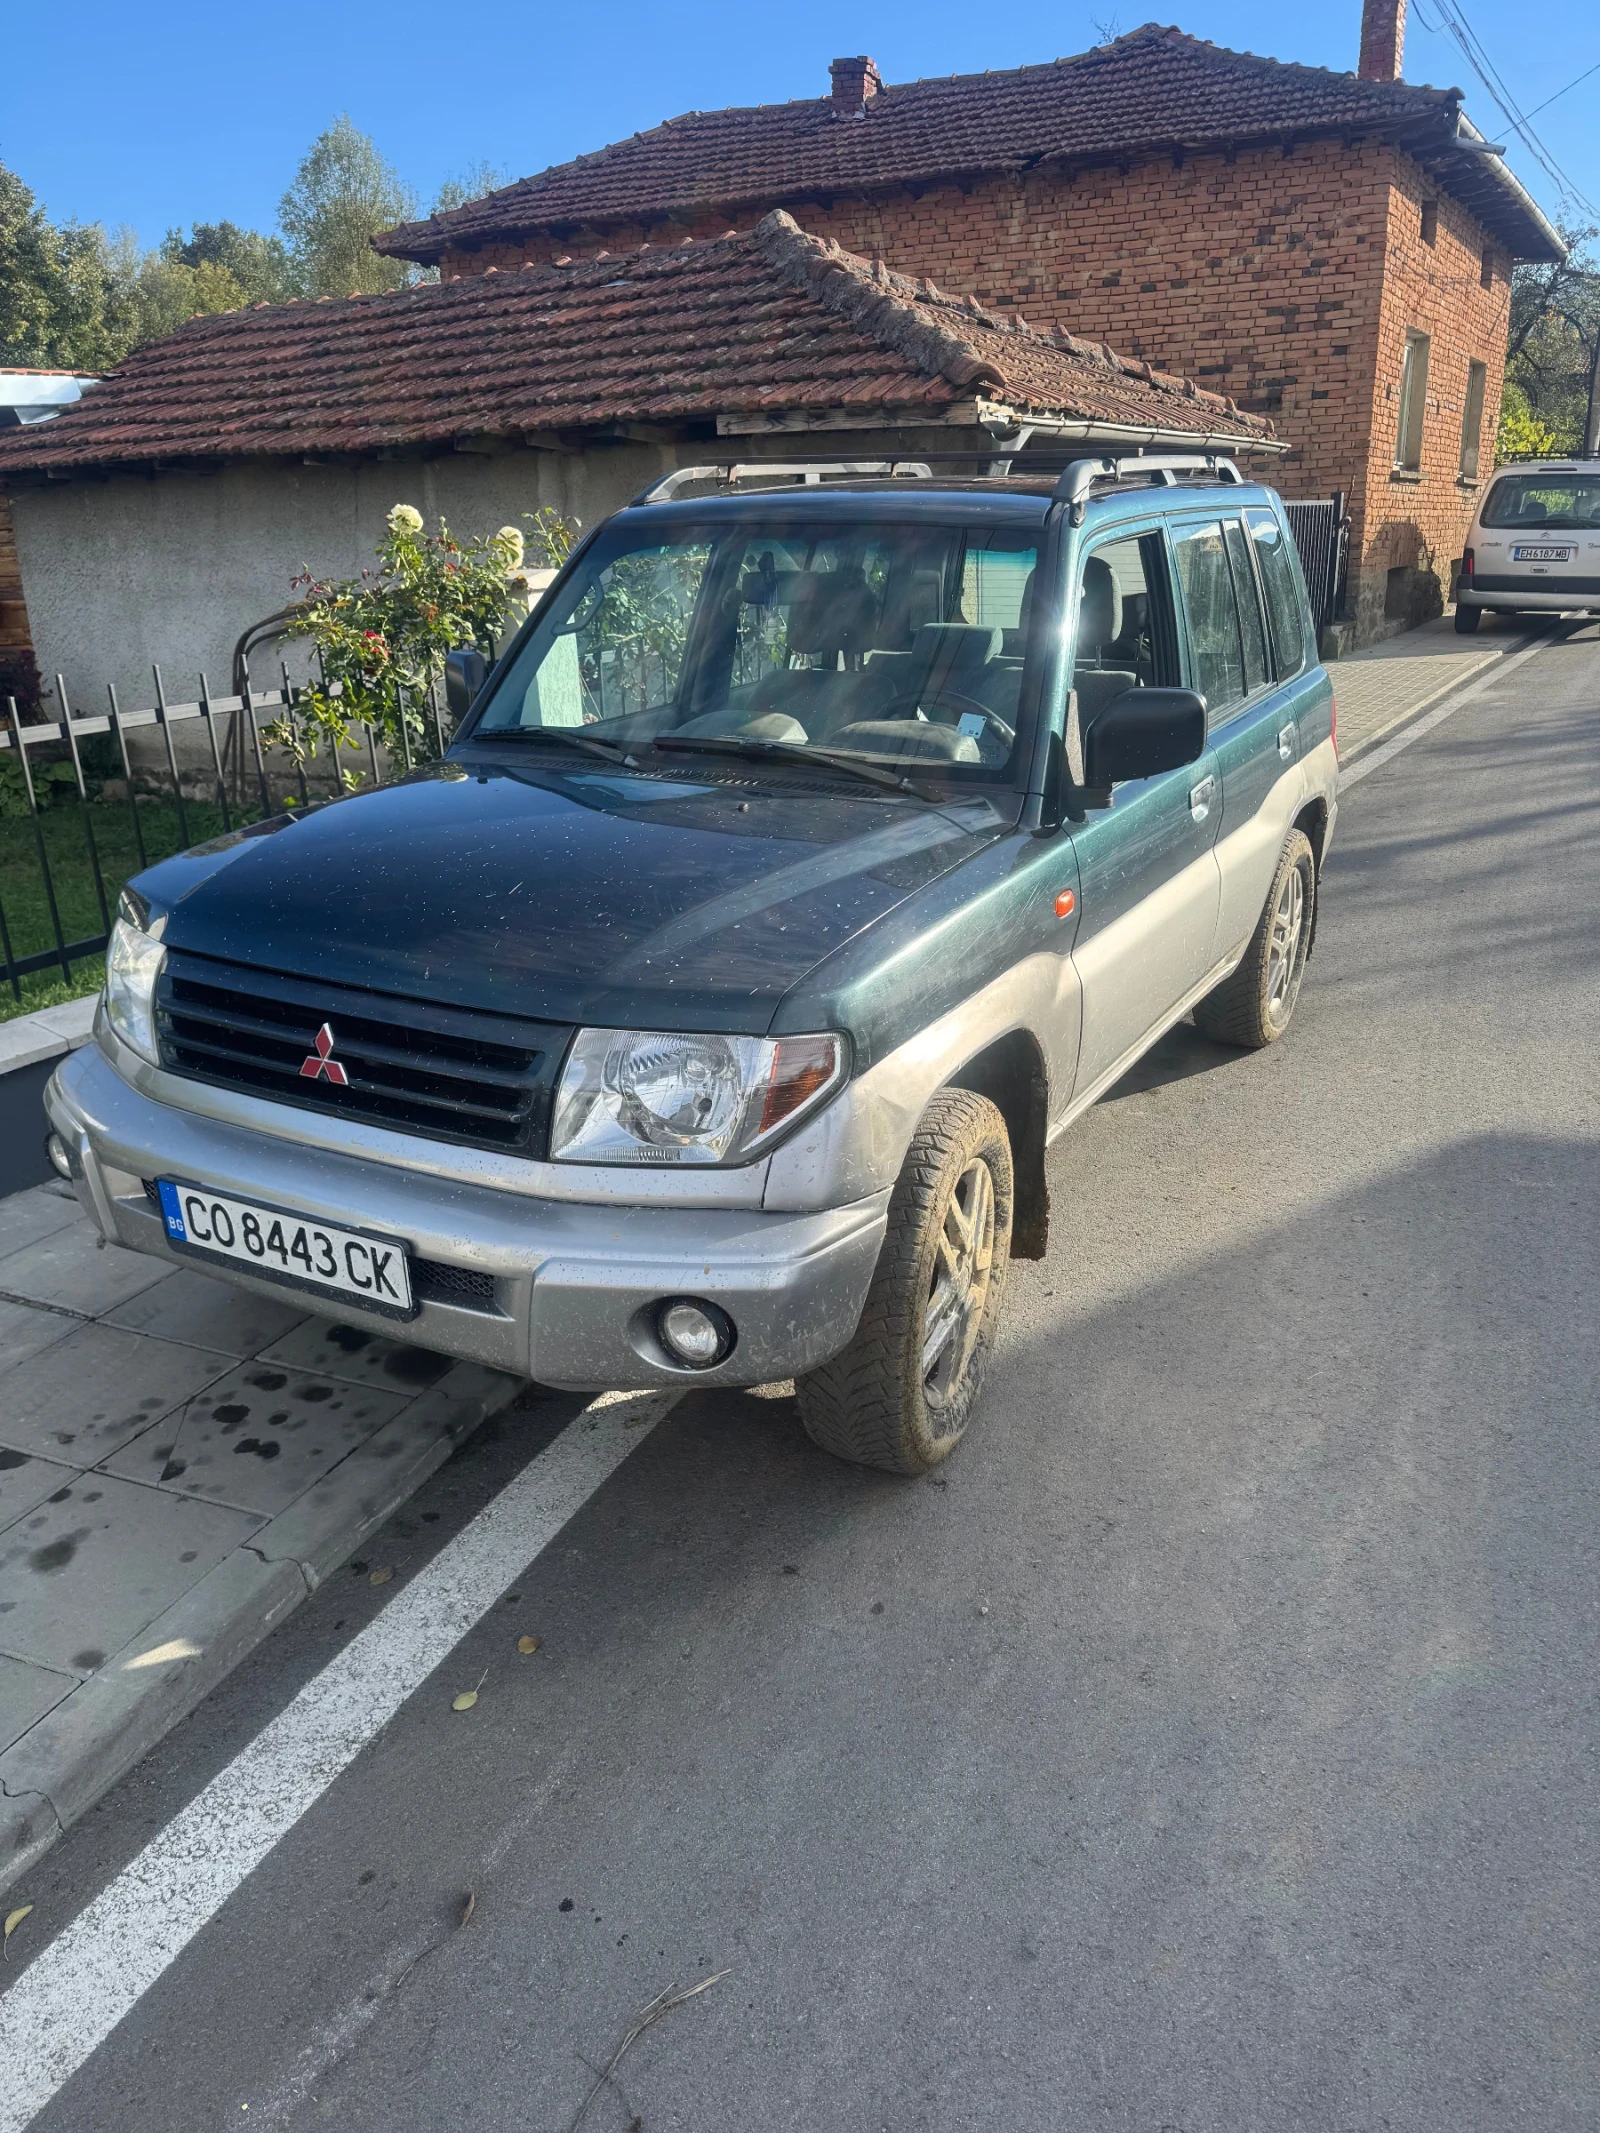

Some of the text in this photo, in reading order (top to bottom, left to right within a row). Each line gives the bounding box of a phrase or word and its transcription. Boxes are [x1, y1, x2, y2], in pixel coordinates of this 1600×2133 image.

[1533, 549, 1555, 558] 6187
[168, 1216, 184, 1231] BG
[185, 1196, 400, 1299] CO 8443 CK
